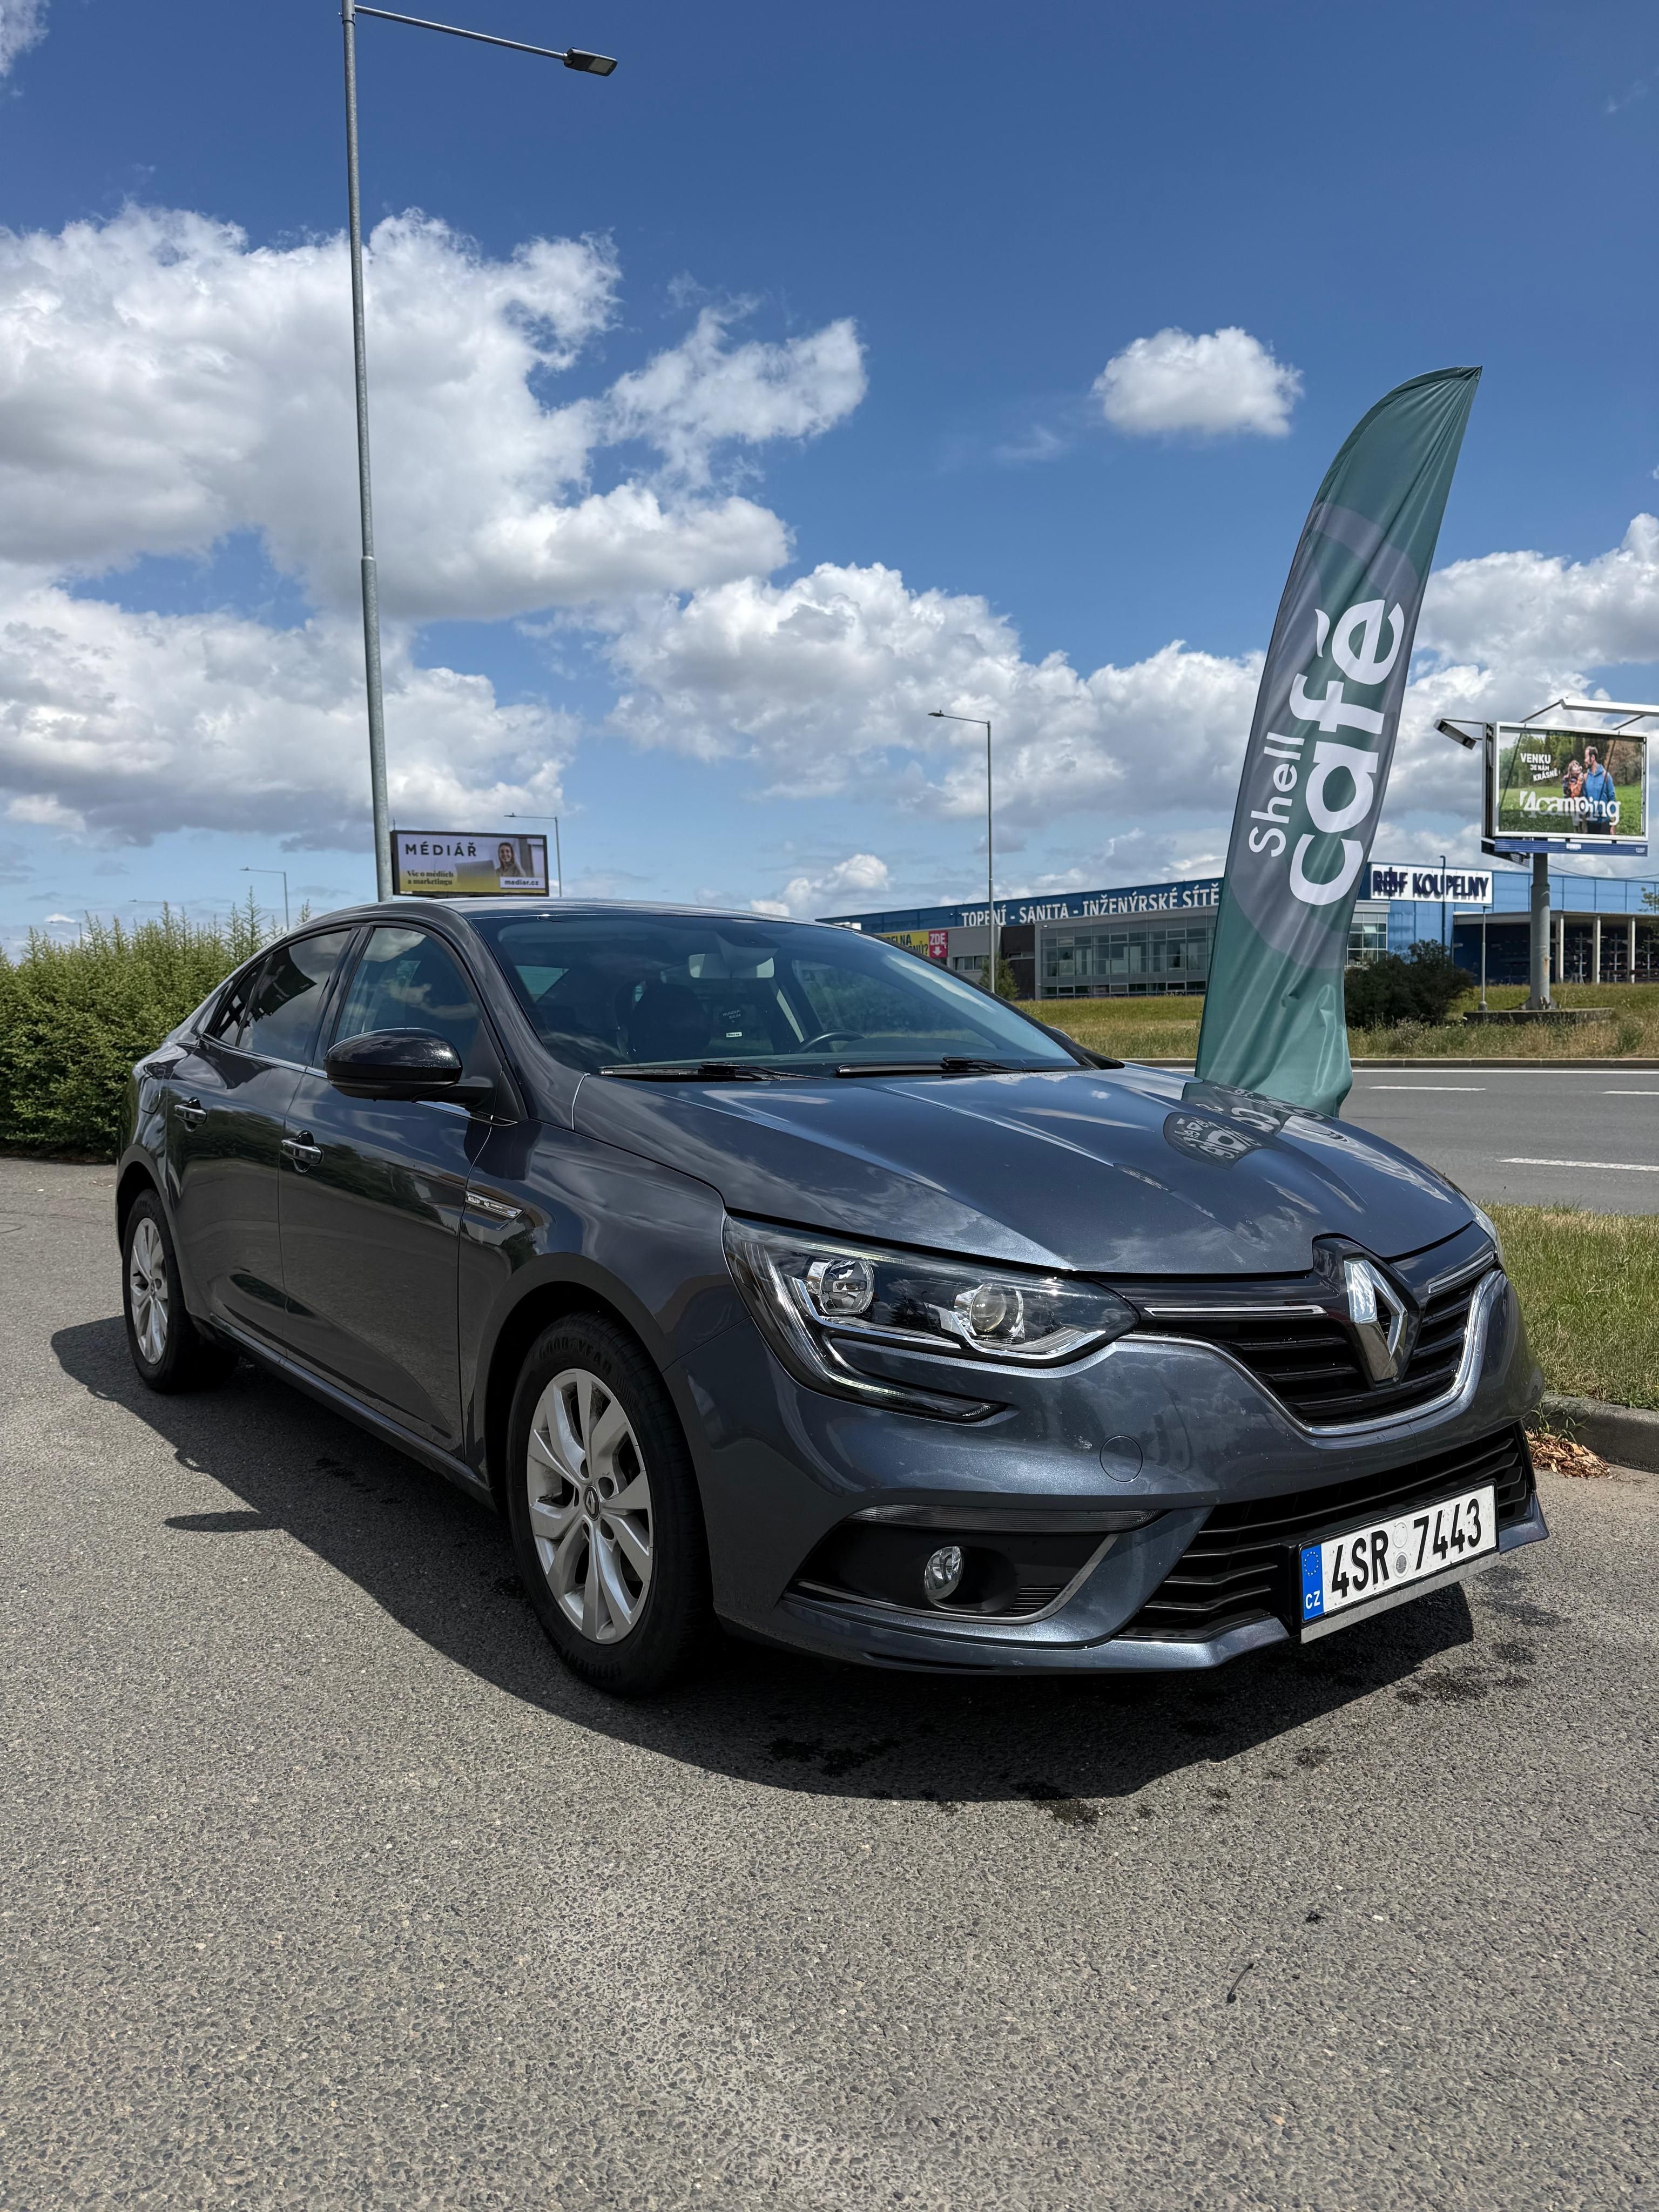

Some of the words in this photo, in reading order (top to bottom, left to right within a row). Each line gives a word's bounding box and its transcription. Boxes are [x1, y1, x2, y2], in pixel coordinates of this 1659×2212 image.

[1289, 599, 1405, 906] café
[1520, 753, 1551, 764] VENKU
[1248, 732, 1305, 858] Shell
[1520, 791, 1621, 826] 4camping
[406, 841, 477, 857] MÉDIÁŘ
[1413, 873, 1489, 898] KOUPELNY
[961, 904, 1007, 927] TOPENÍ
[1019, 903, 1069, 924] SANITA
[1083, 887, 1178, 916] INŽENÝRSKÉ
[1182, 882, 1219, 908] SÍTĚ
[930, 933, 945, 945] ZDE
[539, 1337, 612, 1375] GOODYEAR
[1332, 1530, 1390, 1598] 4SR
[1413, 1499, 1481, 1570] 7443
[1305, 1590, 1320, 1609] CZ
